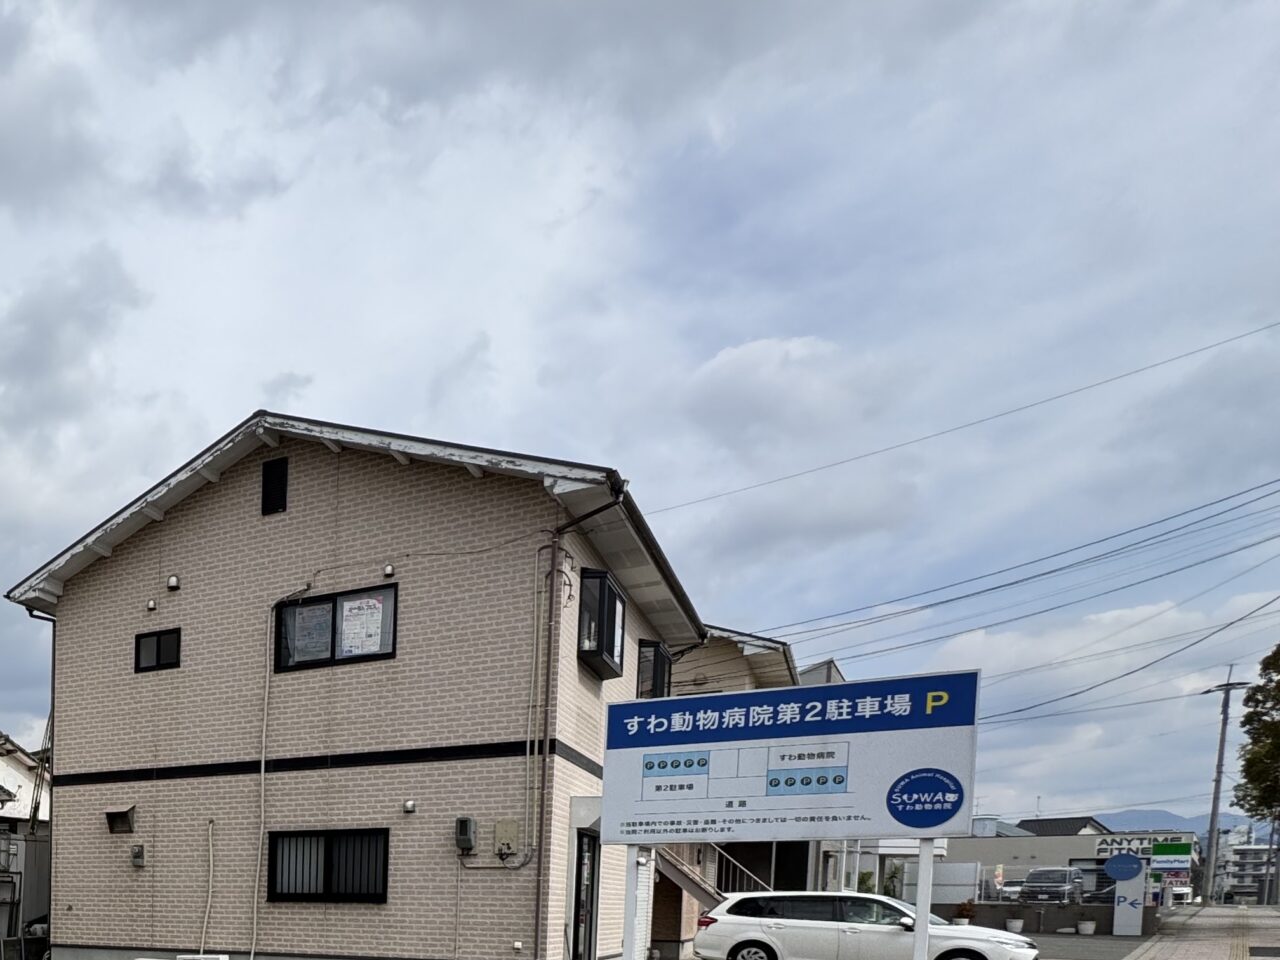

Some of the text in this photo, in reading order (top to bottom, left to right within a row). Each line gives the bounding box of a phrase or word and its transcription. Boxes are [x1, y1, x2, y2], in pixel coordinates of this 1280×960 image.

[623, 691, 949, 735] すわ動物病院第2駐車場 P
[779, 751, 836, 762] すわ動物病院
[910, 772, 934, 780] Animal
[934, 773, 957, 791] Hospital
[654, 783, 694, 792] 第2駐車場
[896, 803, 953, 811] すわ動物病院
[1097, 836, 1183, 847] ANYTIME
[1097, 847, 1152, 856] FITNE
[1117, 896, 1127, 906] P
